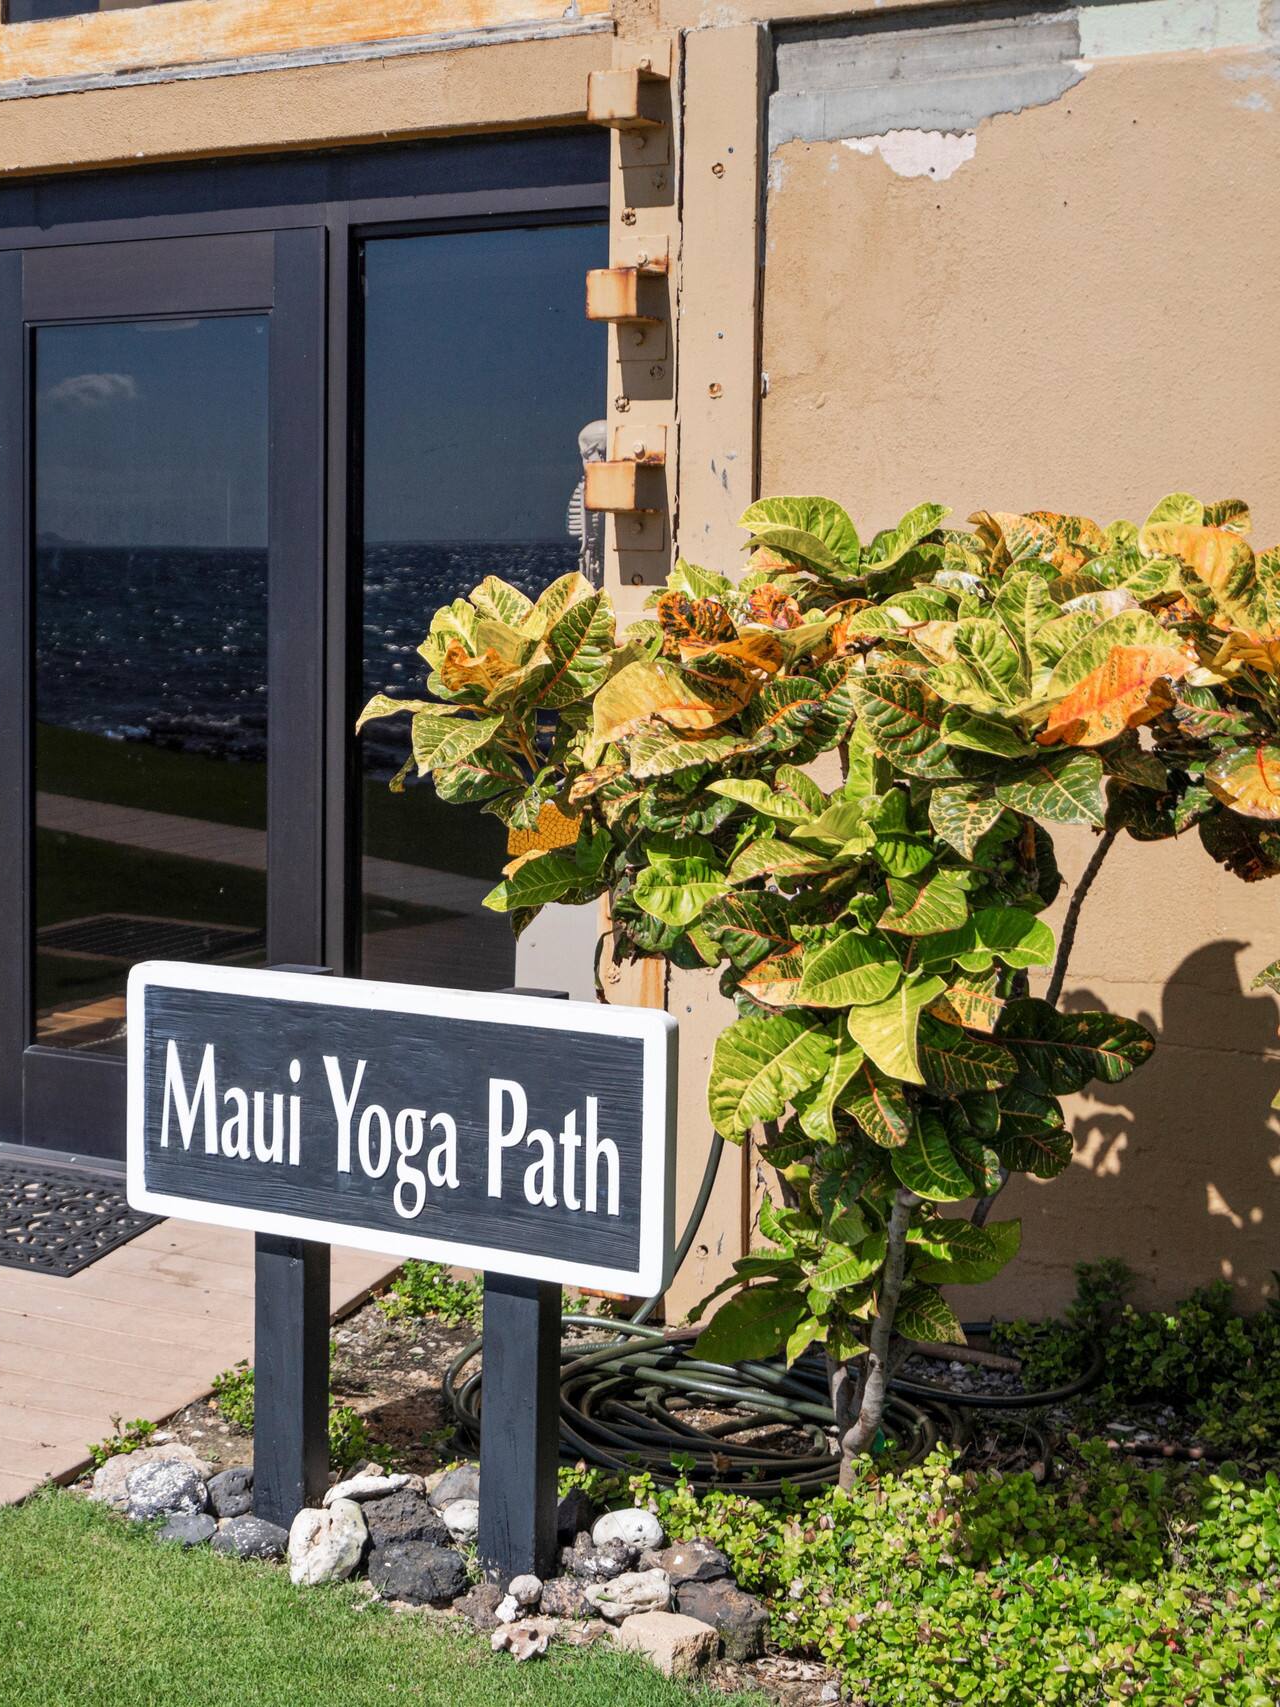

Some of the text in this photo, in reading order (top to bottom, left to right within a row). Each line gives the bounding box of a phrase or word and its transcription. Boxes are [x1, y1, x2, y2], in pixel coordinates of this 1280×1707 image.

[160, 1038, 621, 1220] Maui Yoga Path
